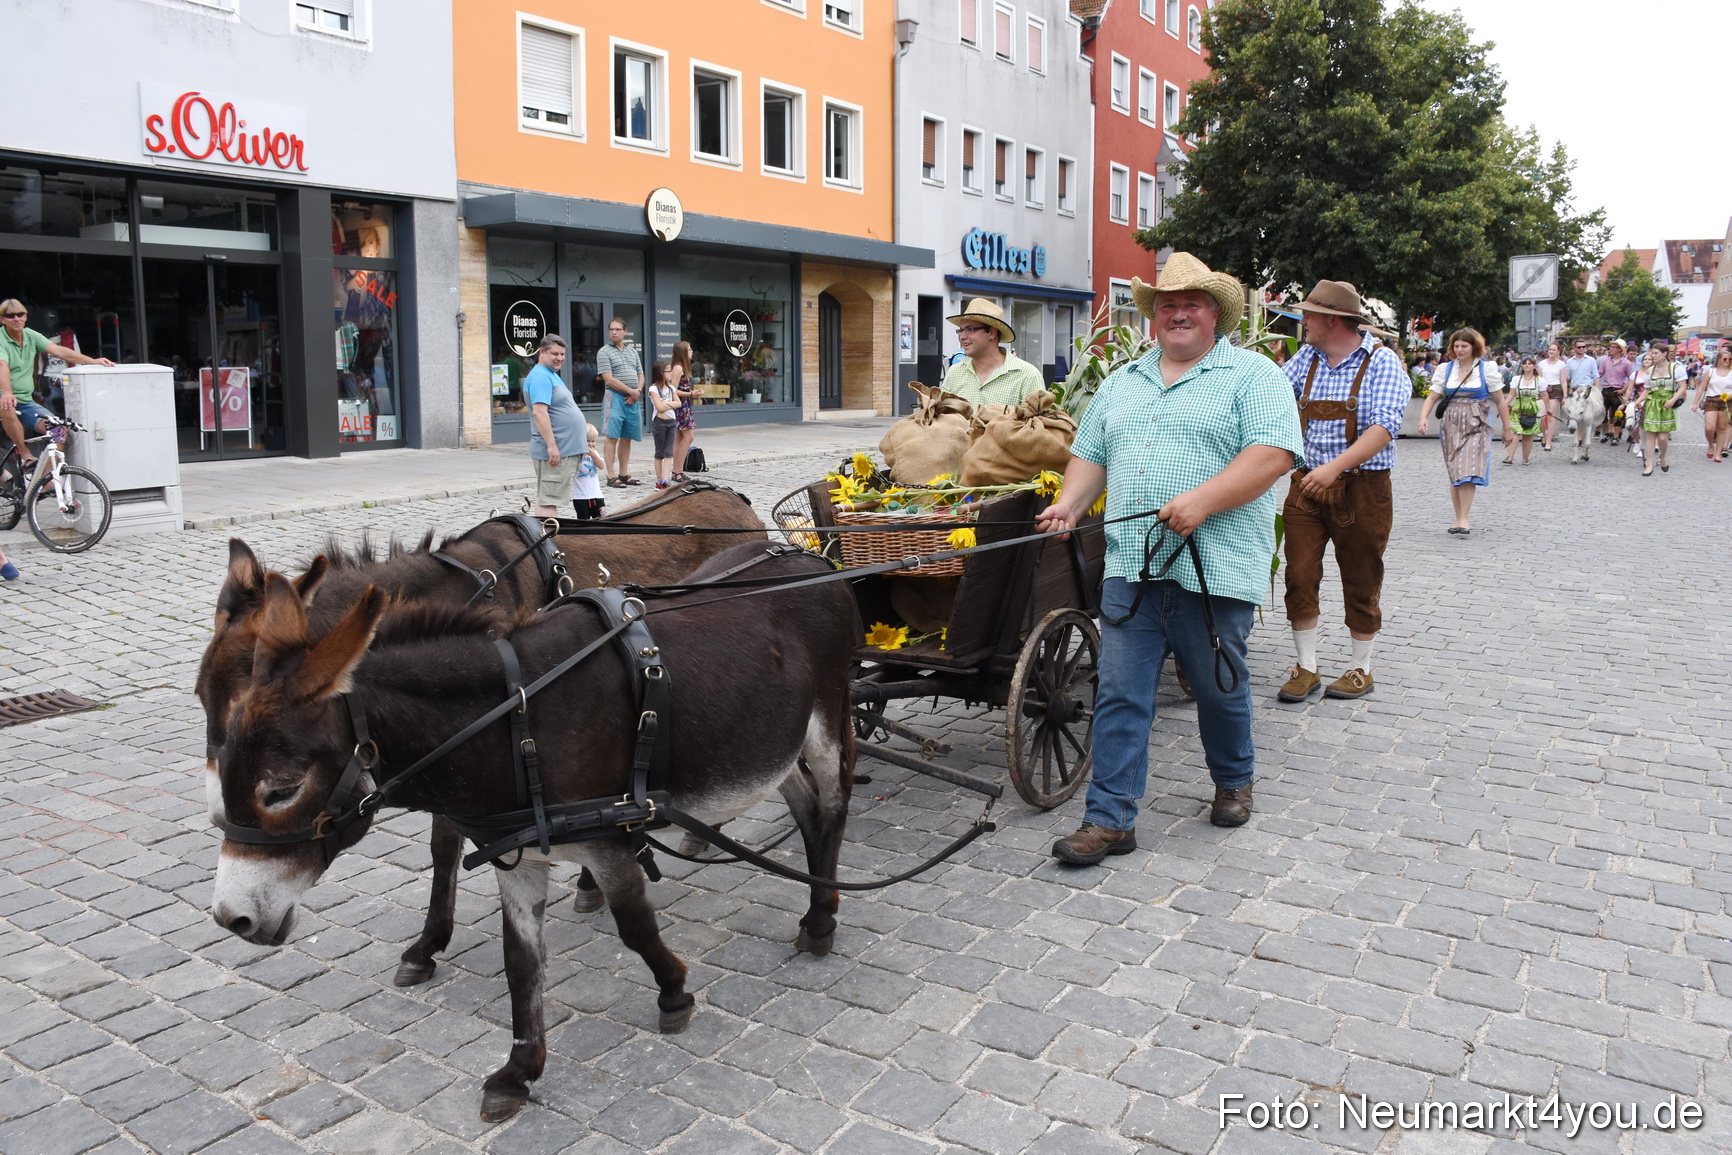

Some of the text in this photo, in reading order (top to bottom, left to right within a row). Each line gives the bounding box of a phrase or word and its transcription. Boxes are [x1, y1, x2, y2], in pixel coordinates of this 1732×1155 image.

[145, 91, 309, 171] s.Oliver
[655, 200, 677, 214] Dianas
[655, 212, 677, 225] Floristik
[355, 271, 398, 309] SALE
[512, 314, 538, 328] Dianas
[730, 321, 748, 332] Dianas
[513, 327, 538, 339] Floristik
[730, 331, 748, 341] Floristik
[340, 415, 374, 432] ALE
